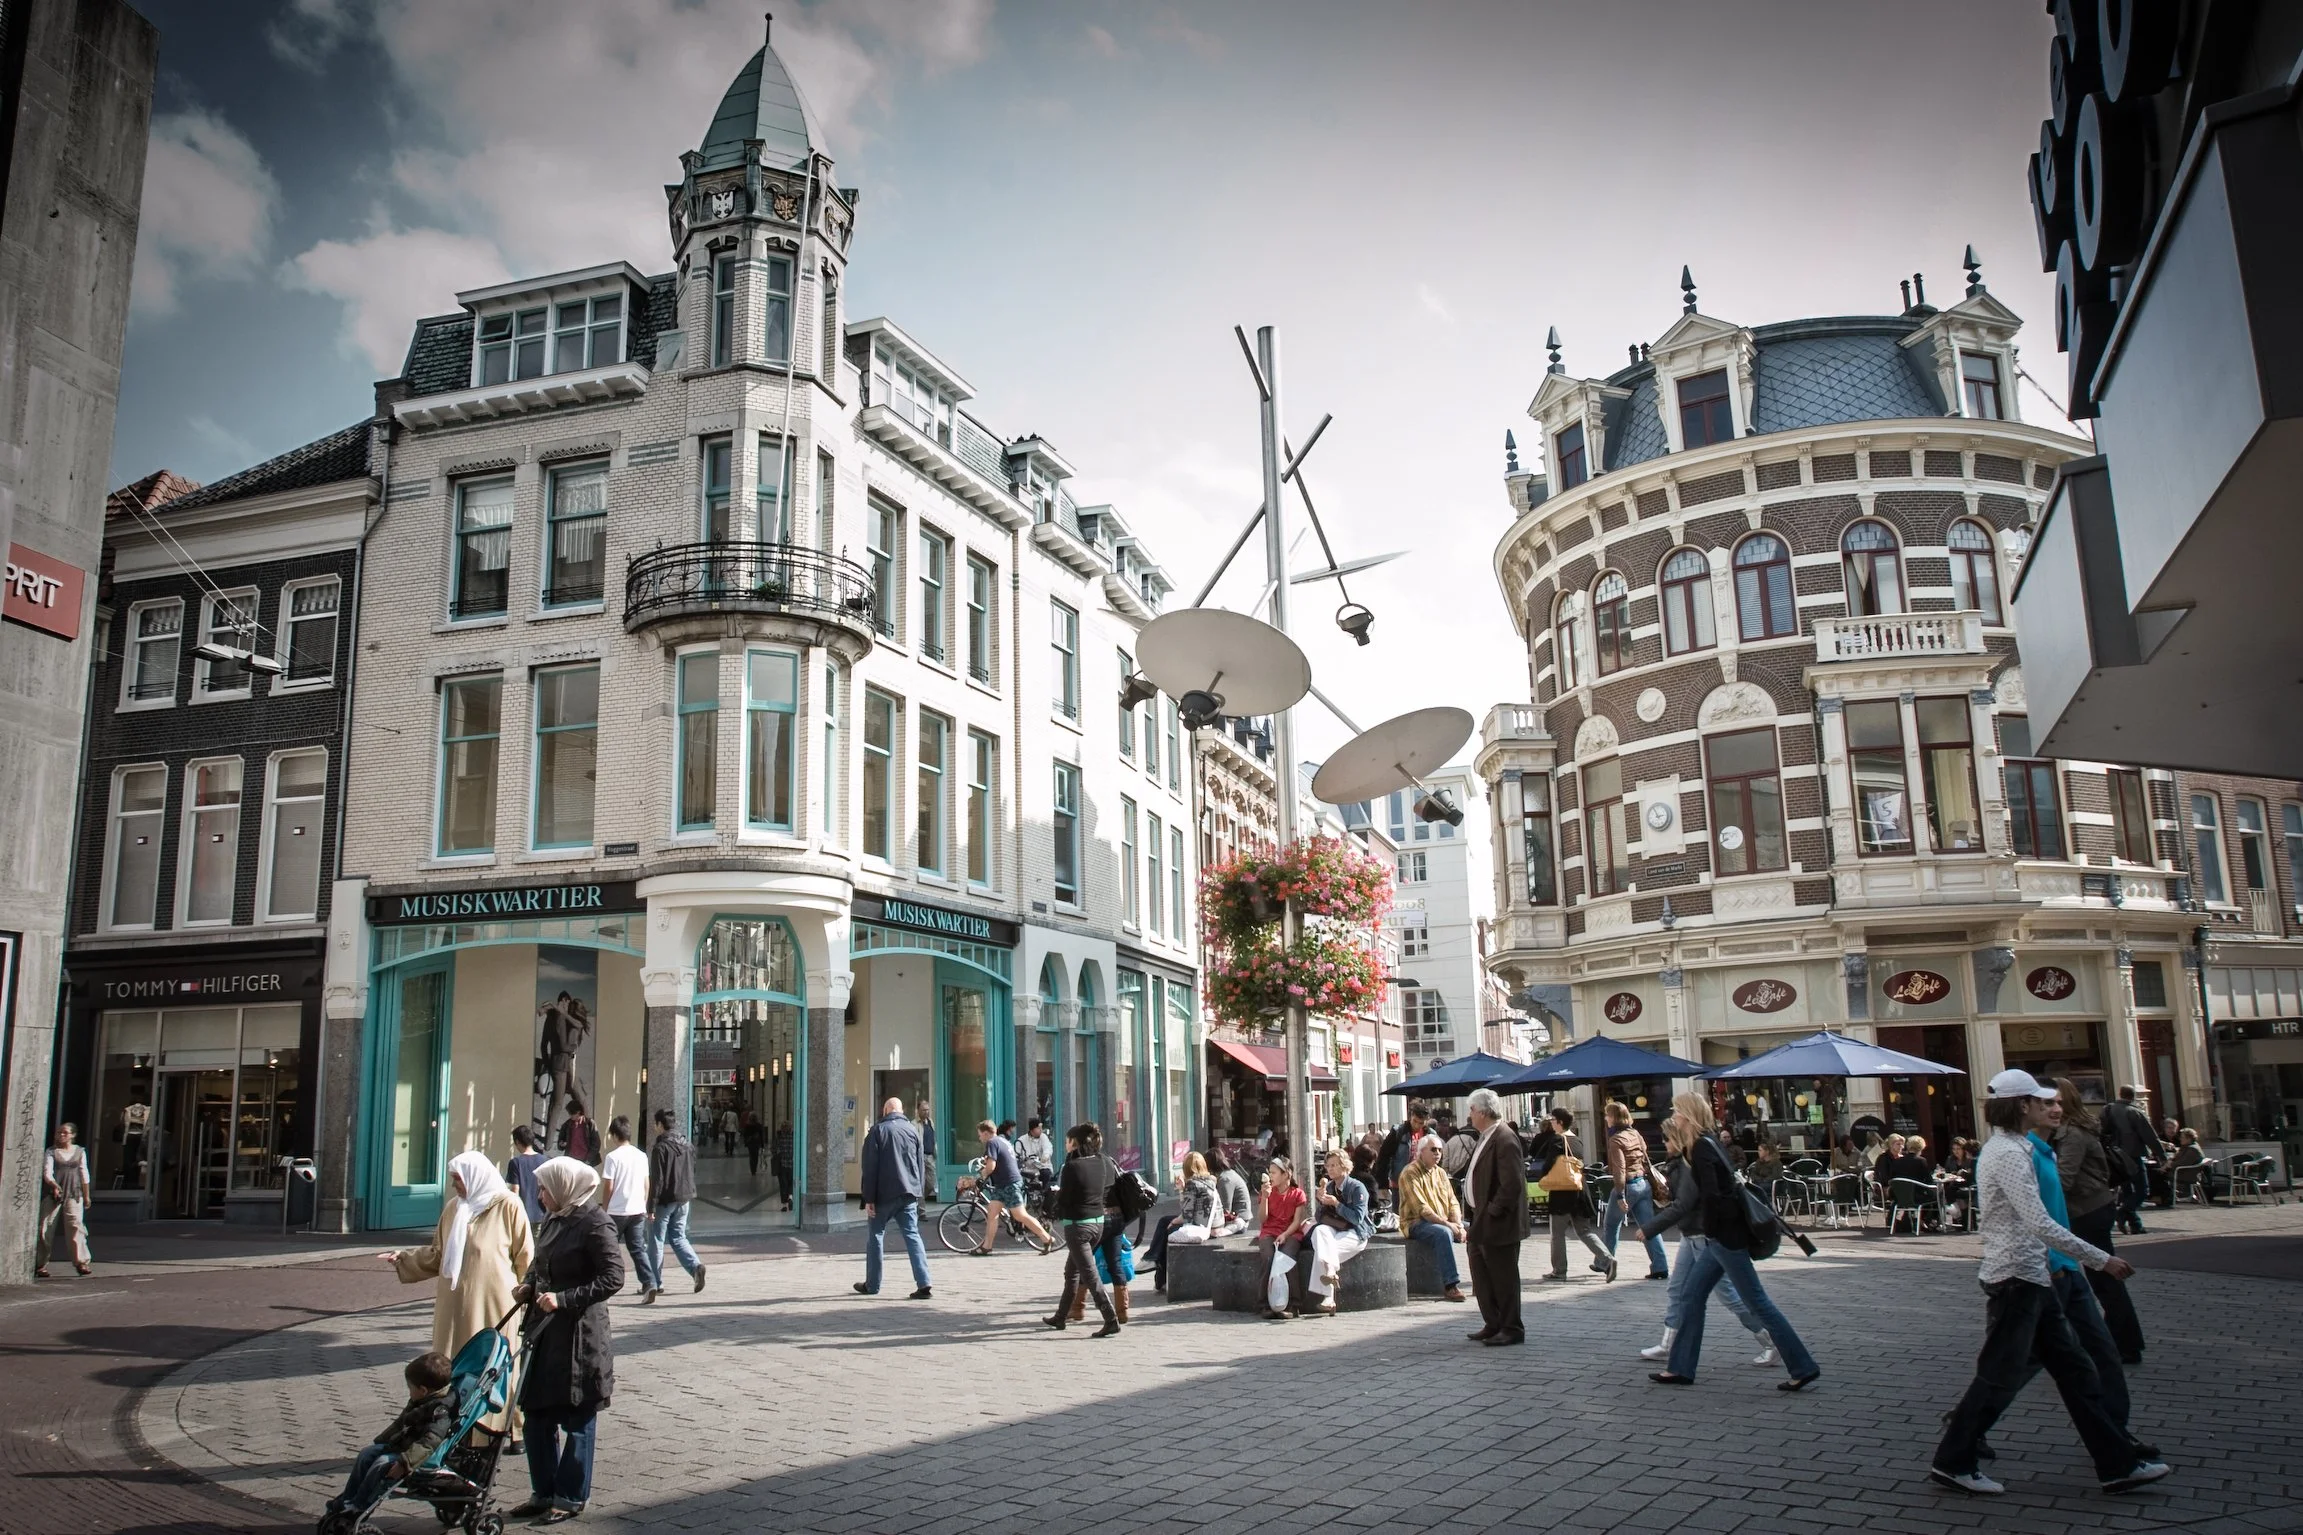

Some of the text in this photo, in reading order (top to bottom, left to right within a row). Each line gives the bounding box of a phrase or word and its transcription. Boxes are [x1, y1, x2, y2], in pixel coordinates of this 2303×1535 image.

[399, 885, 603, 918] MUSISKWARTIER
[884, 899, 991, 938] MUSISKWARTIER
[104, 974, 282, 999] TOMMY HILFIGER
[2272, 1022, 2300, 1034] HTR
